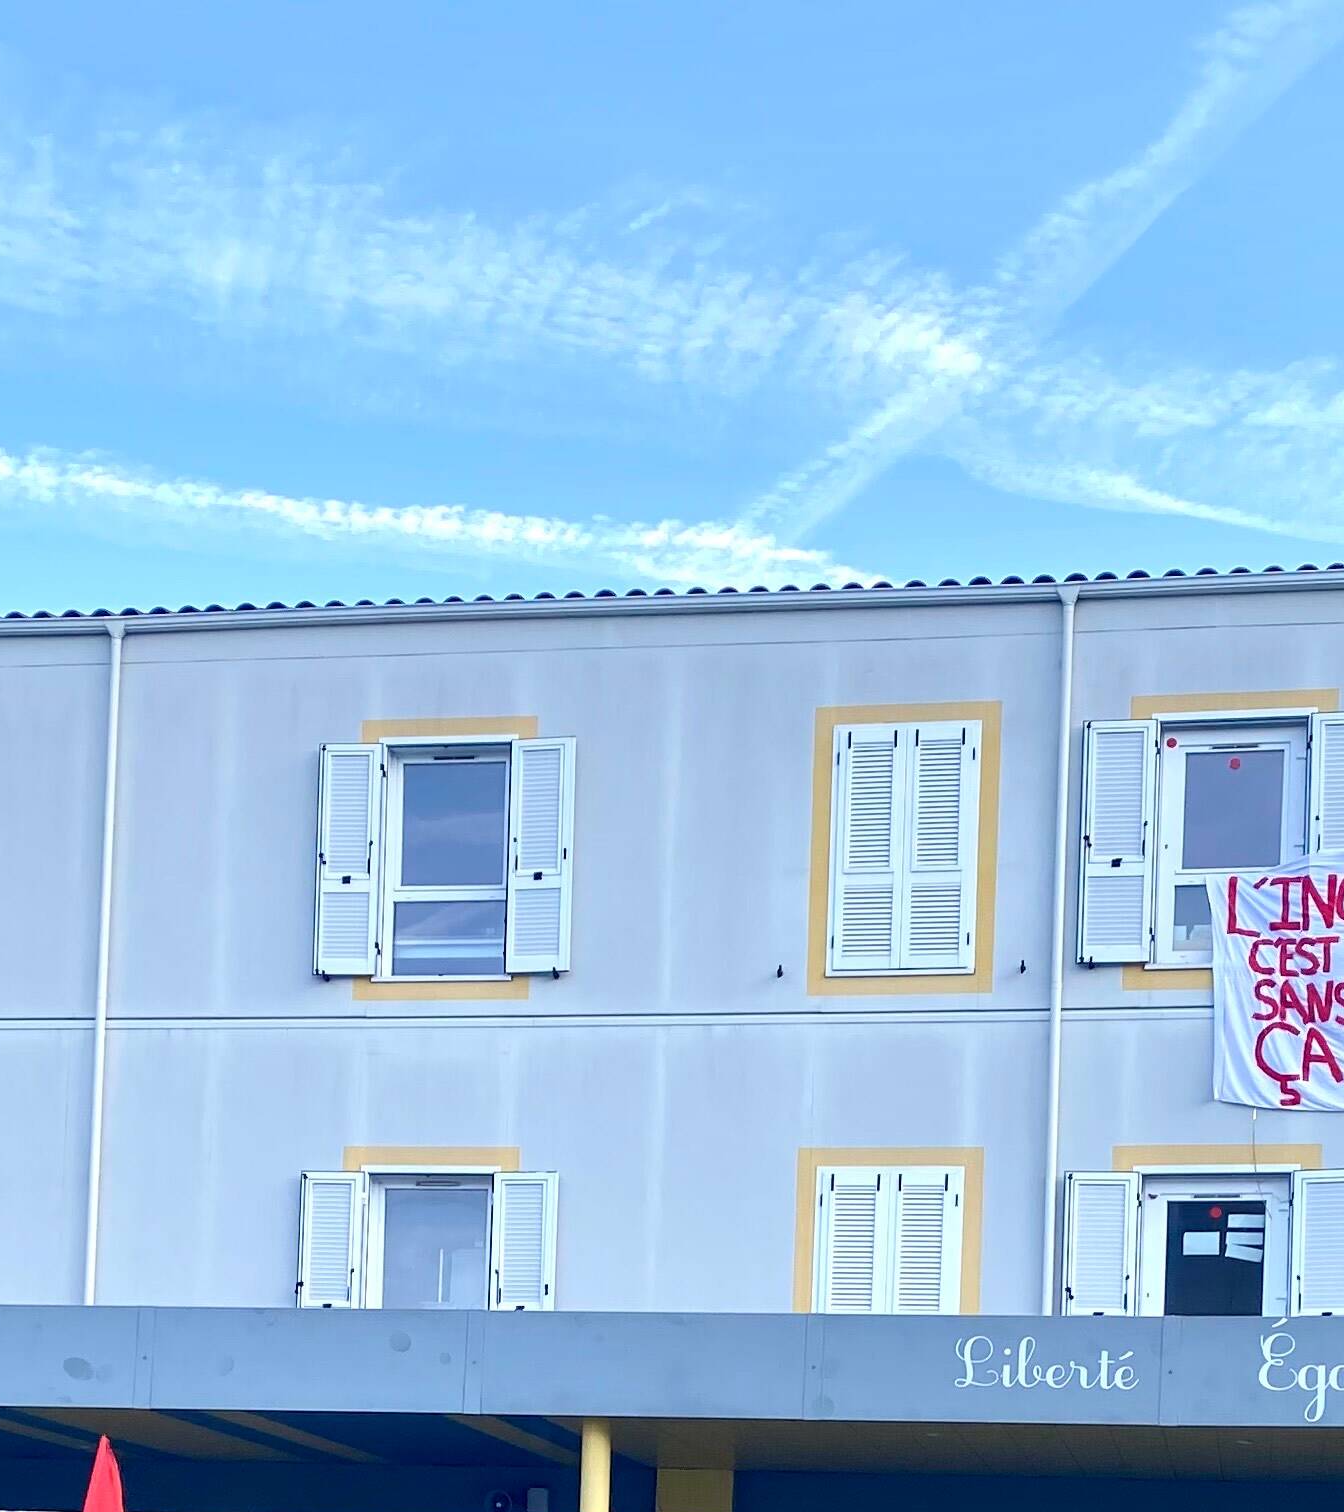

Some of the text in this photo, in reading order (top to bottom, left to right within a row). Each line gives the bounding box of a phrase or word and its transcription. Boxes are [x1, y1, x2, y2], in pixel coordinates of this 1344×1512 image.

[1249, 935, 1340, 977] C'EST
[1254, 1022, 1344, 1106] ÇA
[954, 1336, 1140, 1391] Liberté
